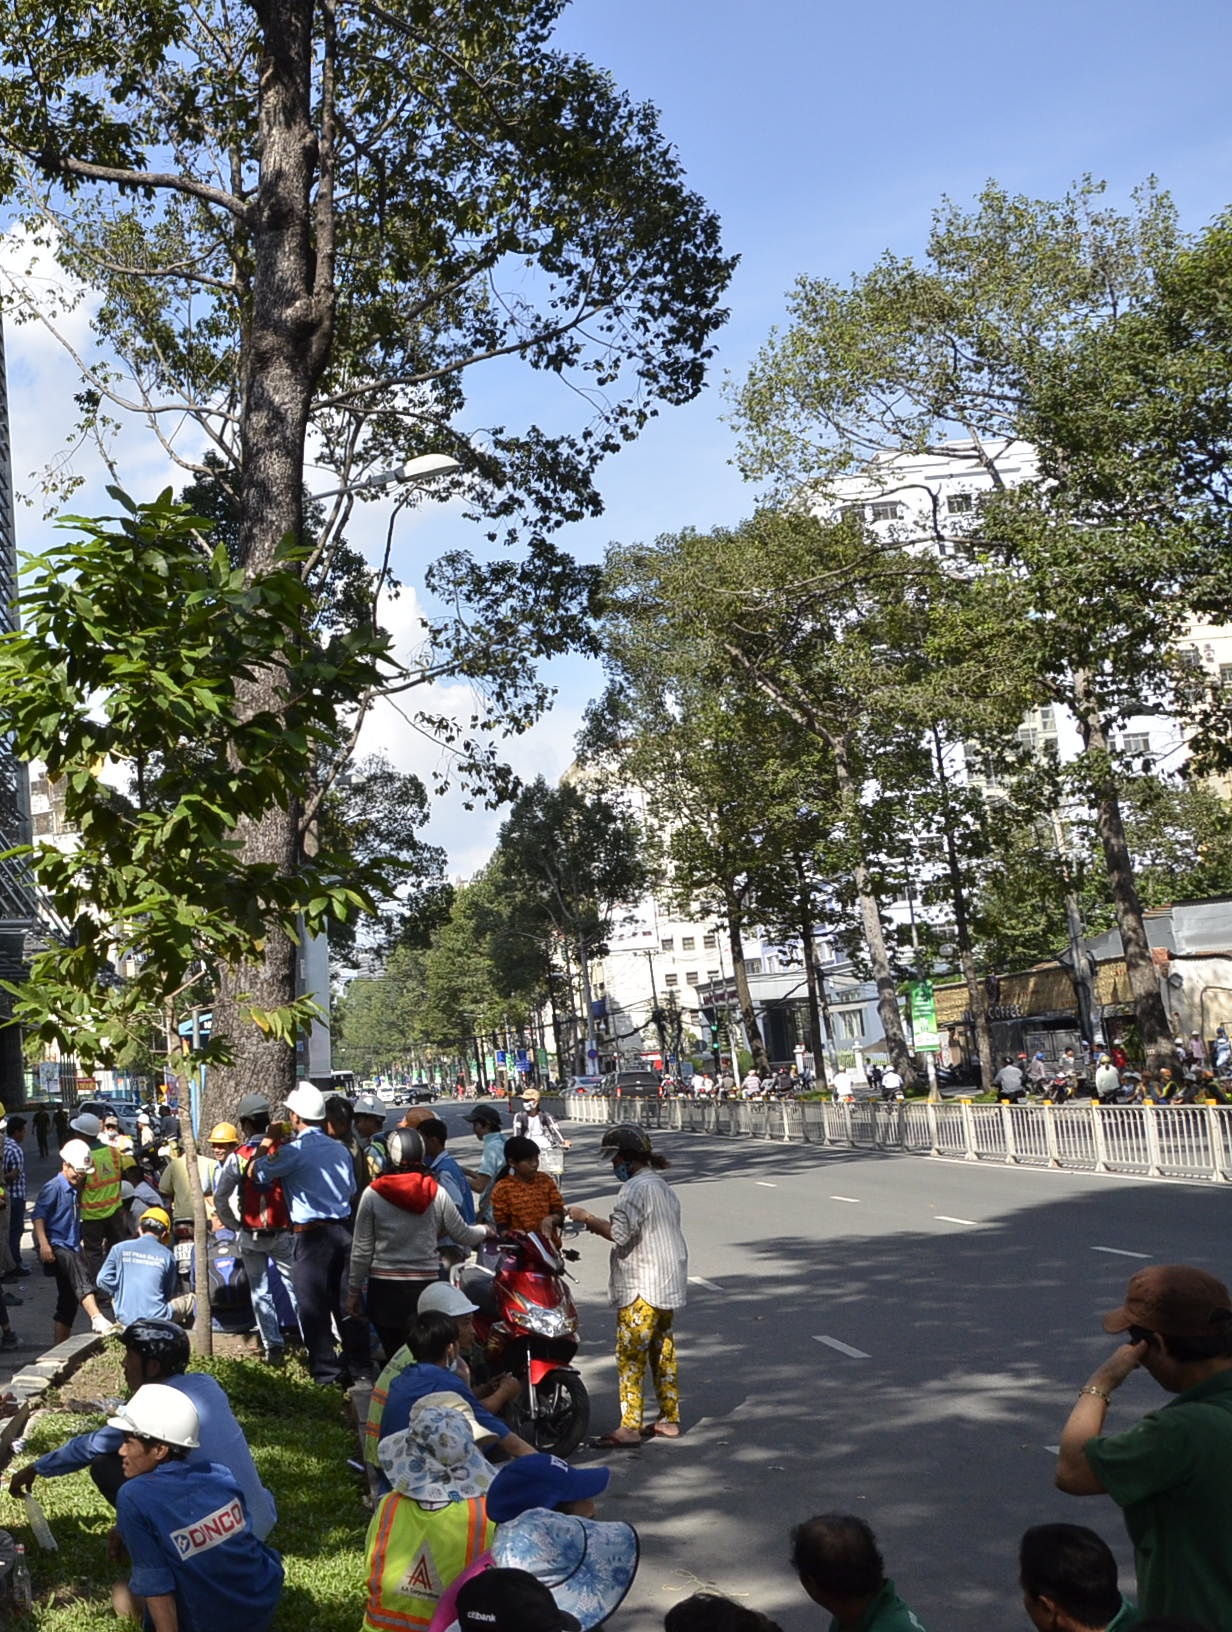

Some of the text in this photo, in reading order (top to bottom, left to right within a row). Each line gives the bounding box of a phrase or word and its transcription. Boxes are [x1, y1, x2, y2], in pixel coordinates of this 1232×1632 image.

[988, 1004, 1021, 1019] COFFEE
[189, 1504, 242, 1548] DINCO
[467, 1611, 496, 1622] citibank
